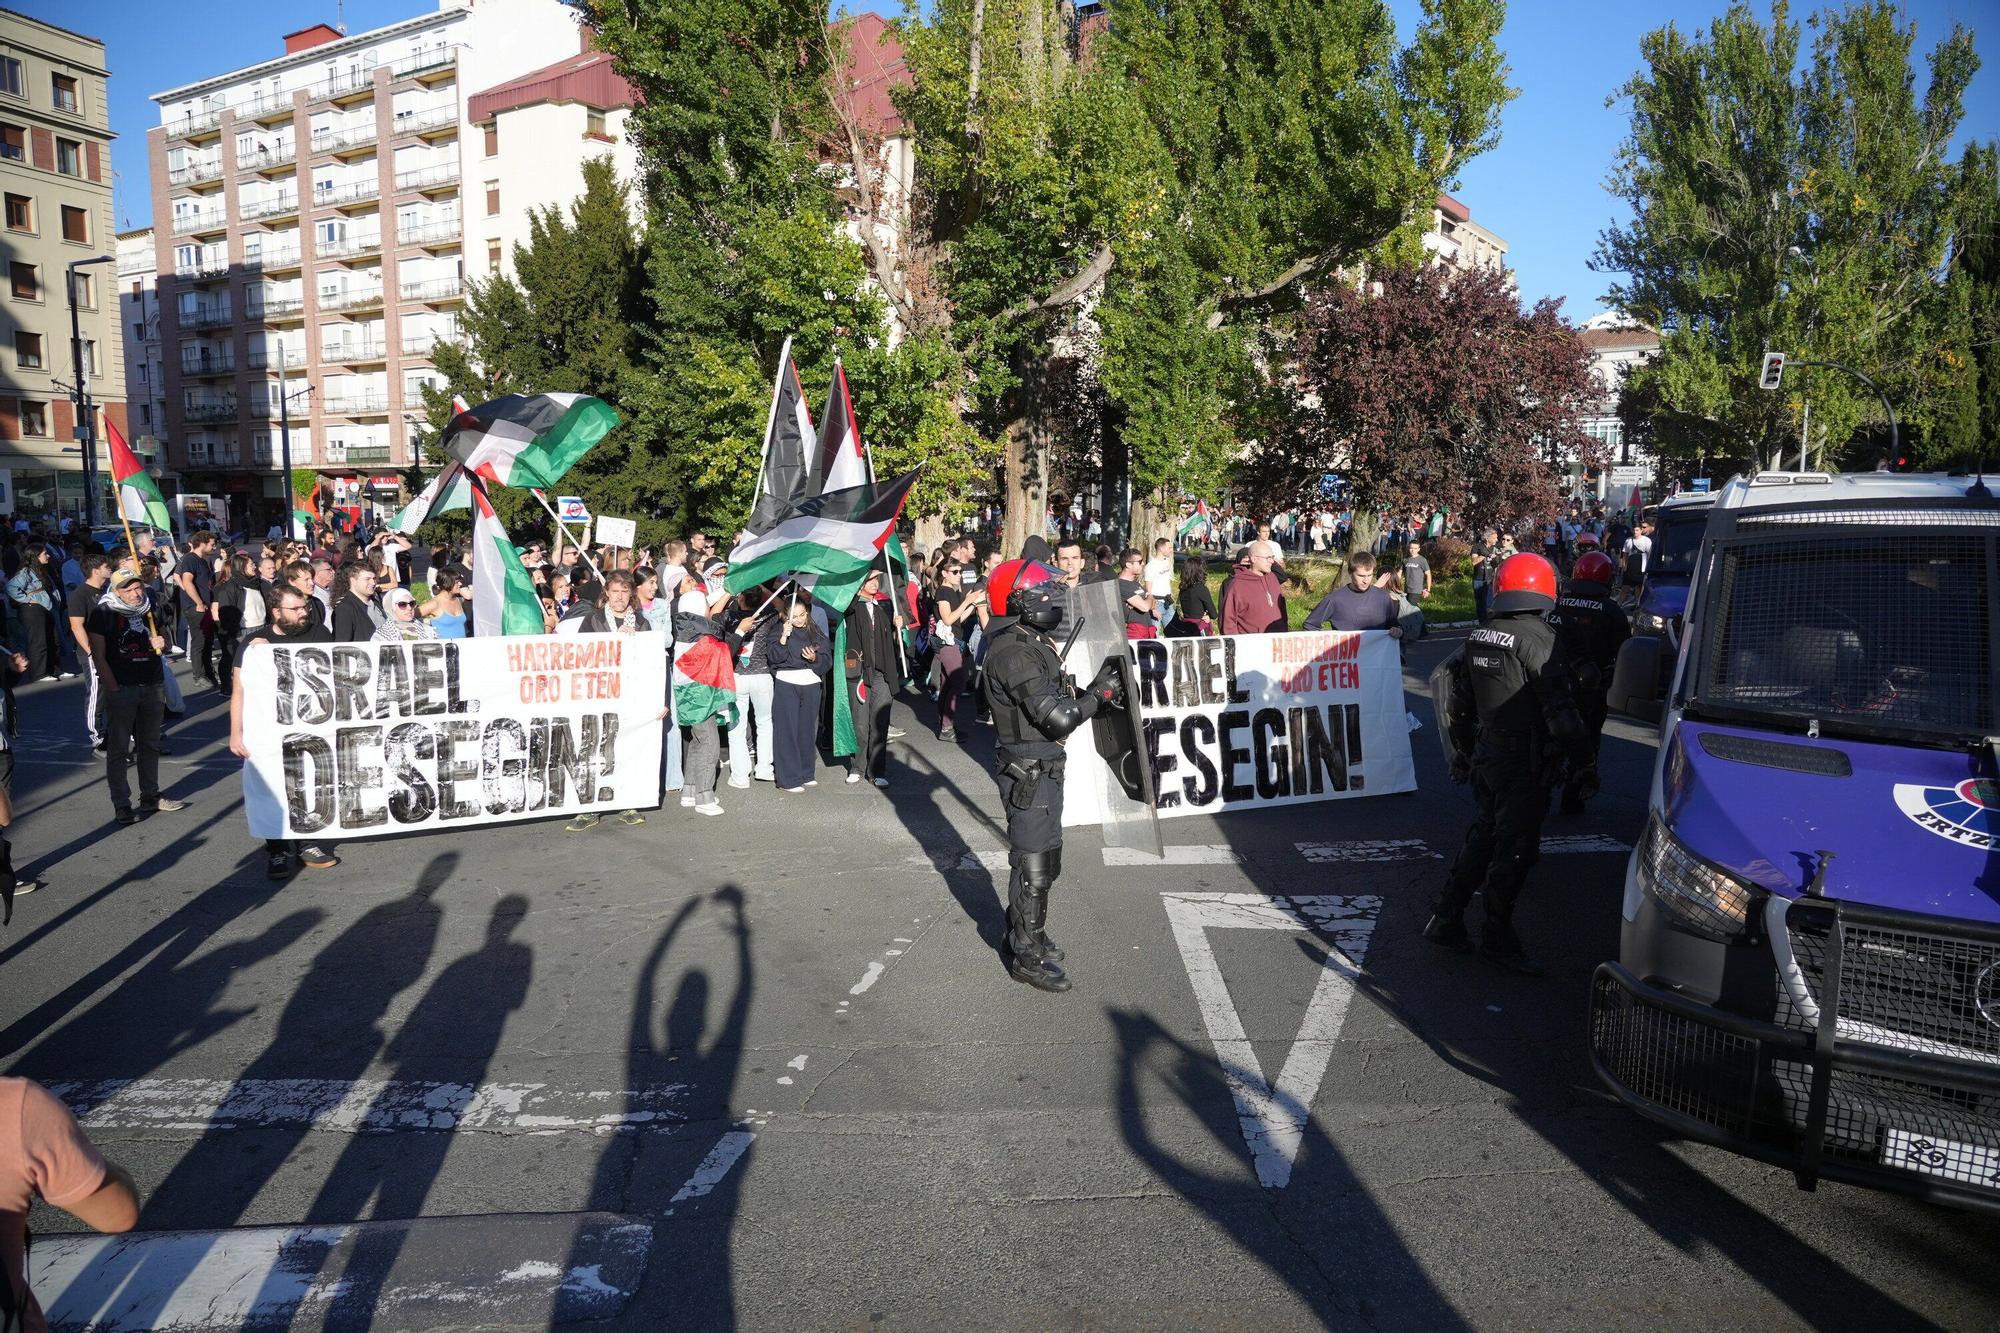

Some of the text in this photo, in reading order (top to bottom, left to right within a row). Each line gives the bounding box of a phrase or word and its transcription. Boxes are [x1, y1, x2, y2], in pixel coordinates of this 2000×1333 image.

[1559, 597, 1603, 611] RTZAINTZA
[1272, 633, 1360, 663] HARREMAN
[1468, 629, 1515, 648] ERTZAINTZA
[507, 640, 622, 671] HARREMAN
[273, 643, 480, 725] ISRAEL
[520, 671, 621, 704] ORO ETEN
[1129, 638, 1249, 708] RAEL
[1281, 662, 1360, 693] ORO ETEN
[282, 712, 619, 833] DESEGIN!
[1143, 704, 1365, 809] ESEGIN!
